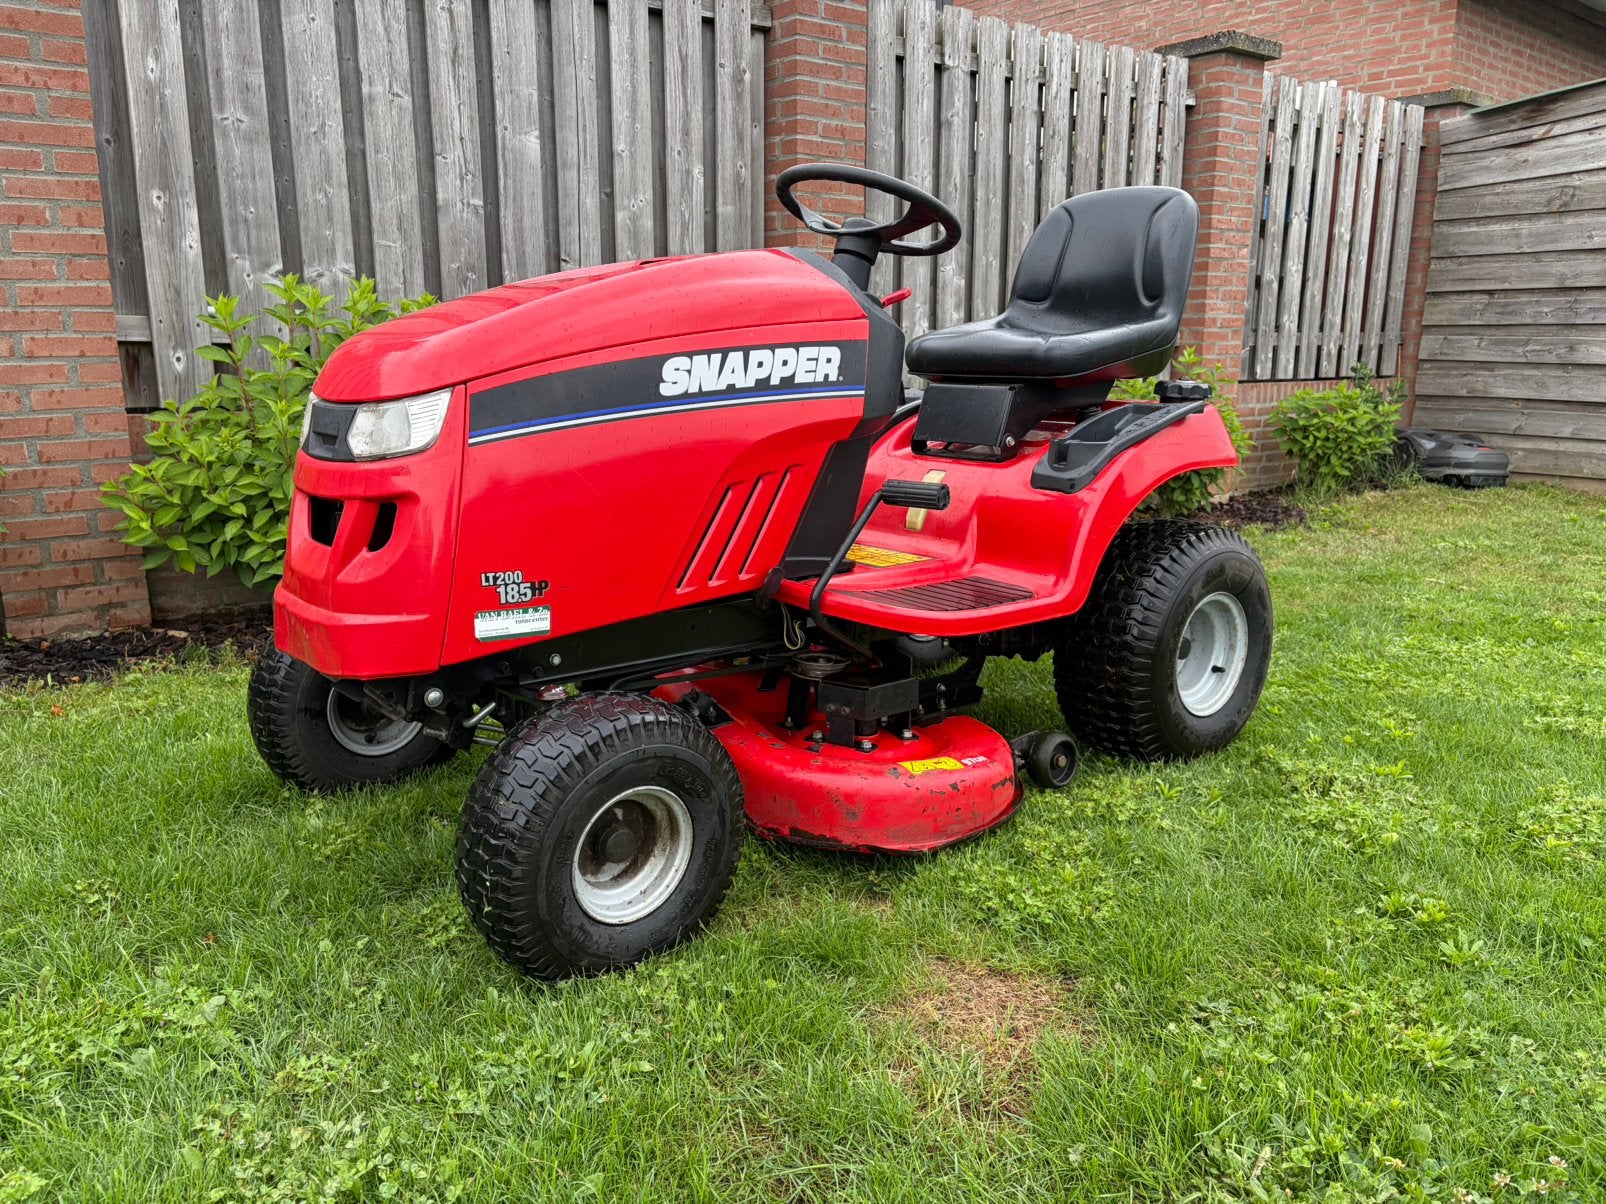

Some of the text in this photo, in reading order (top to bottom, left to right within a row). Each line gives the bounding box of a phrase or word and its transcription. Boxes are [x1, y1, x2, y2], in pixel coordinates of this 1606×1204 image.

[659, 346, 842, 397] SNAPPER
[481, 570, 523, 587] LT200
[478, 611, 498, 622] VAN
[500, 609, 525, 619] BAEL
